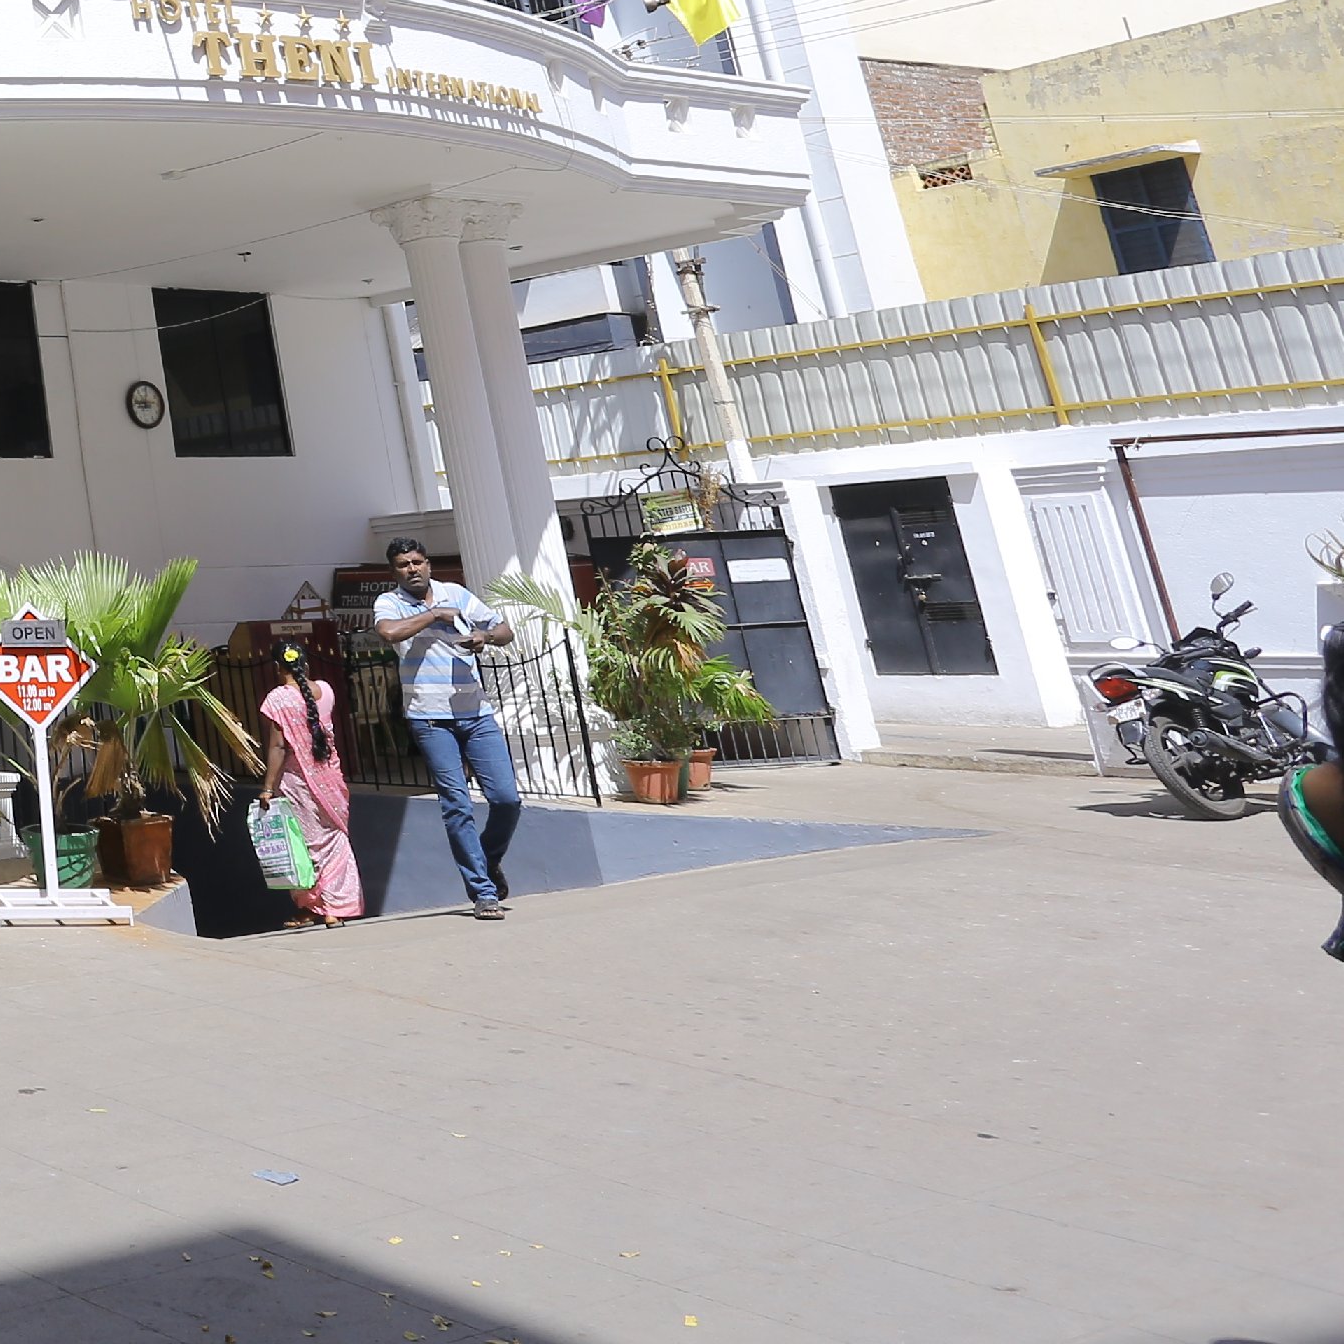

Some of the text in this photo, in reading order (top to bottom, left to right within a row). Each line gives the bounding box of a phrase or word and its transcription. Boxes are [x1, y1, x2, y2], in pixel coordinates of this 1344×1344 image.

[193, 31, 379, 85] THENI
[385, 67, 542, 113] INTERNATIONAL
[687, 561, 711, 573] AR
[360, 581, 400, 592] HOTE
[341, 595, 369, 607] THENI
[12, 626, 56, 641] OPEN
[23, 697, 42, 711] 12.00
